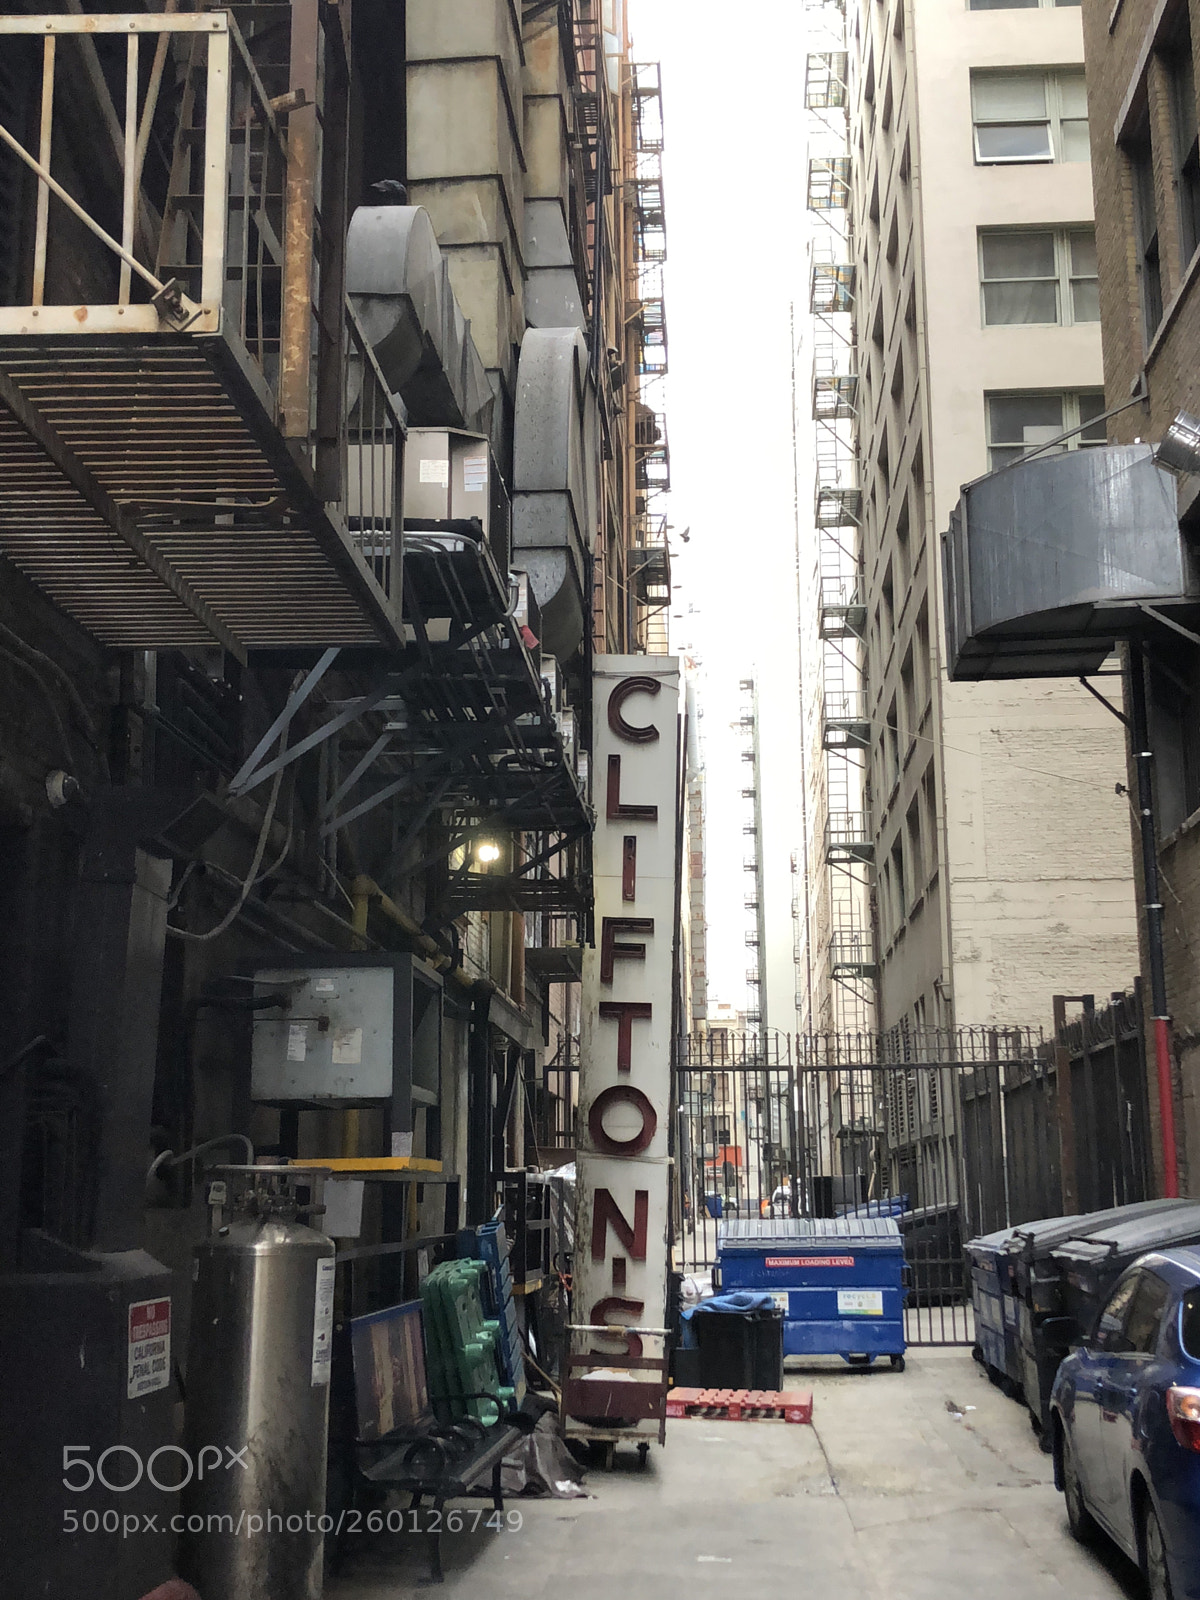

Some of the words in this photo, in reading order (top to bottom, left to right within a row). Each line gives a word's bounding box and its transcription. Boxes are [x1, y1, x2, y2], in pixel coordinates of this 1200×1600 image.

[768, 1258, 800, 1267] MAXIMUM
[801, 1258, 831, 1266] LOADING
[832, 1257, 853, 1266] LEVEL
